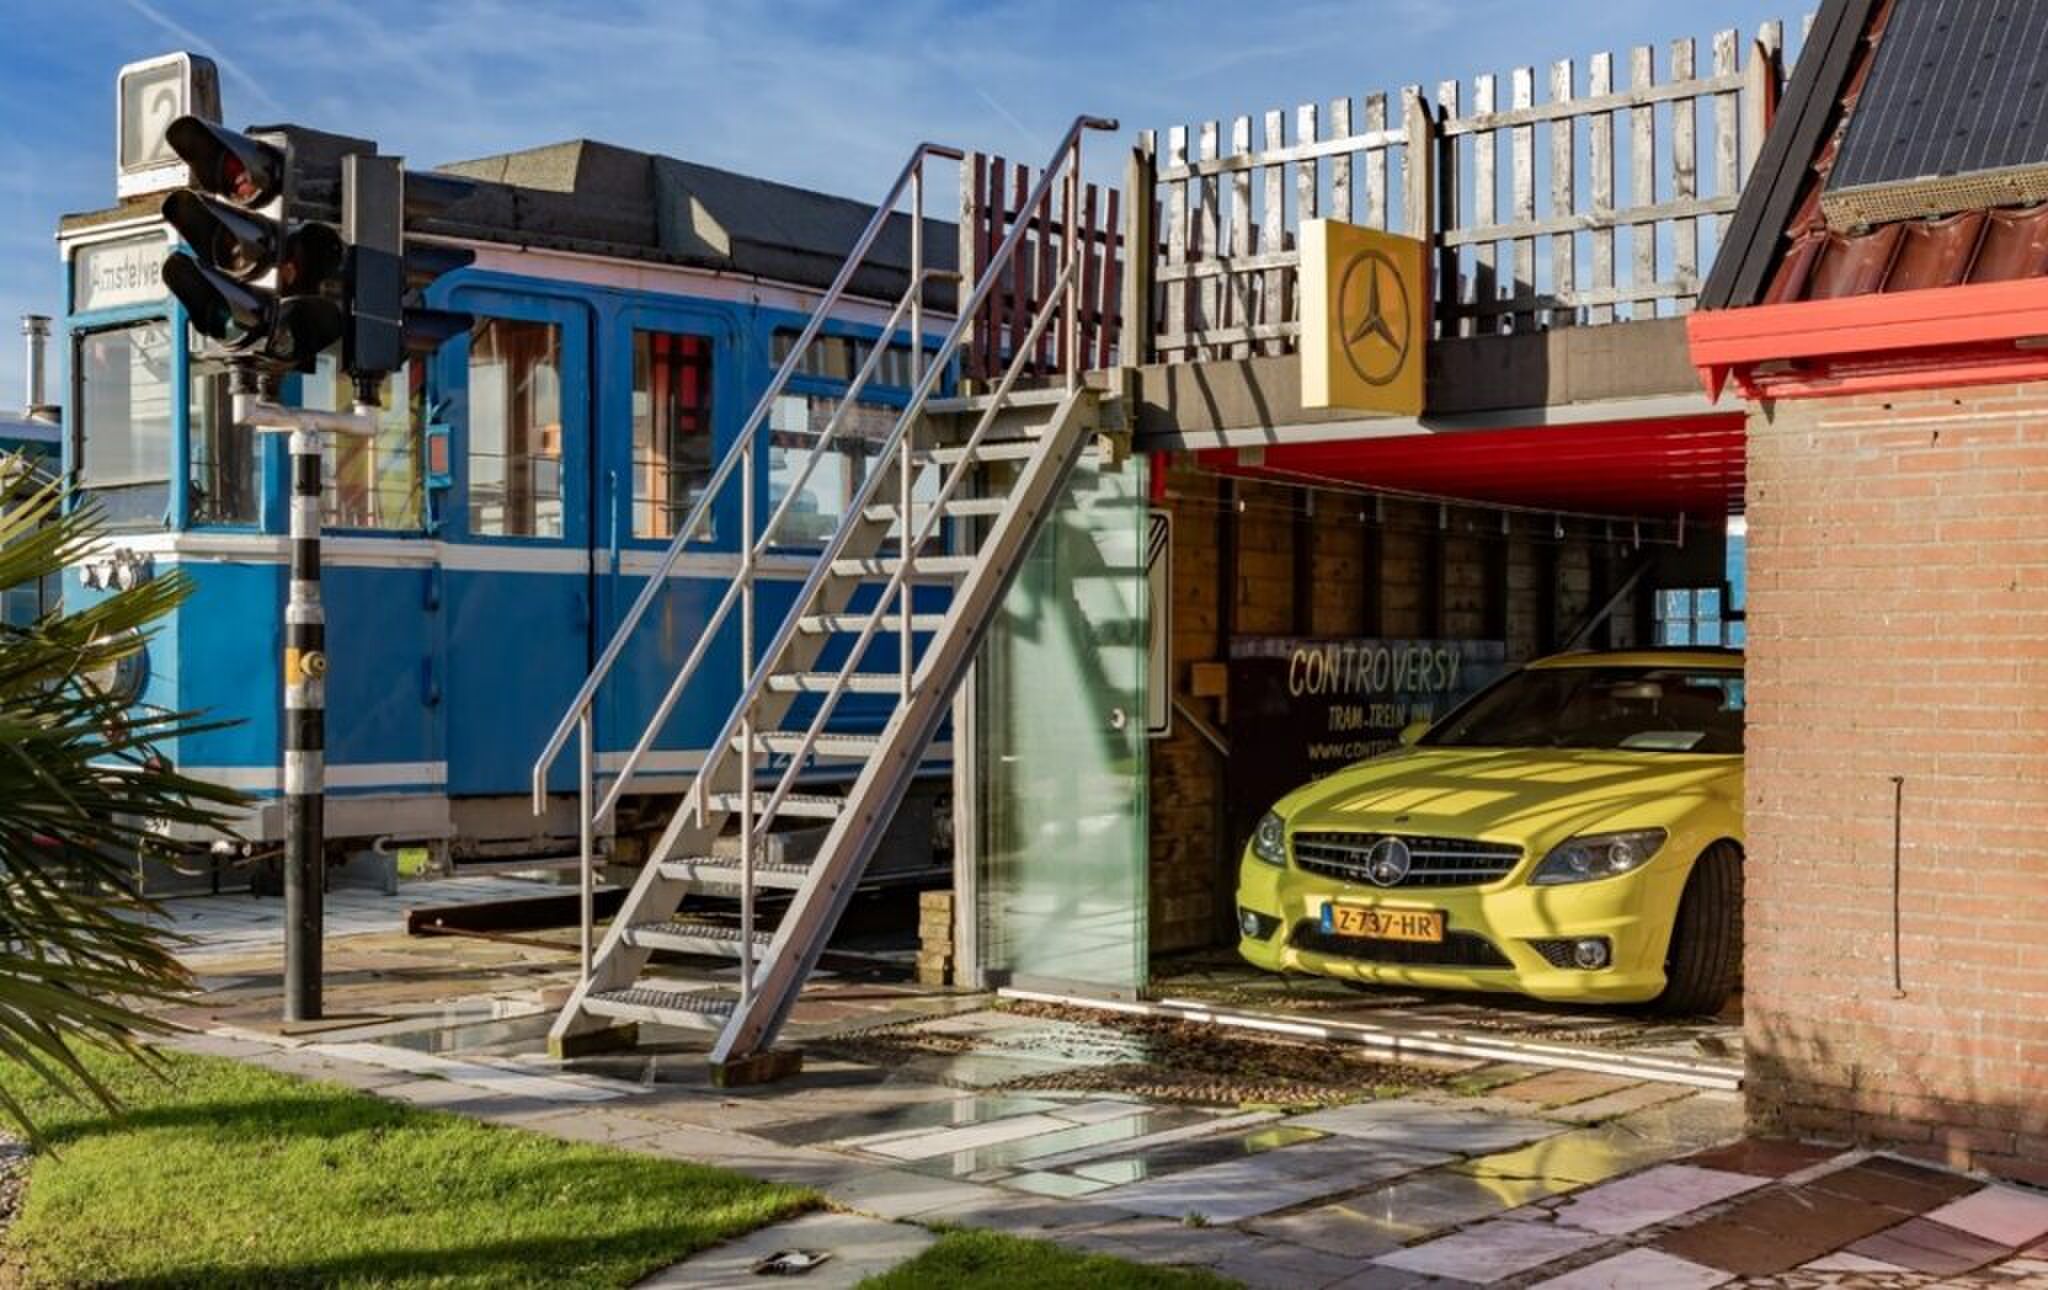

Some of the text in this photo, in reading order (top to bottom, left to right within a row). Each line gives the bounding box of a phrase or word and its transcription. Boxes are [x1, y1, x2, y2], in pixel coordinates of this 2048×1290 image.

[149, 88, 177, 161] 2
[1289, 646, 1460, 697] CONTROVERSY
[1340, 909, 1431, 938] Z-737-HR
